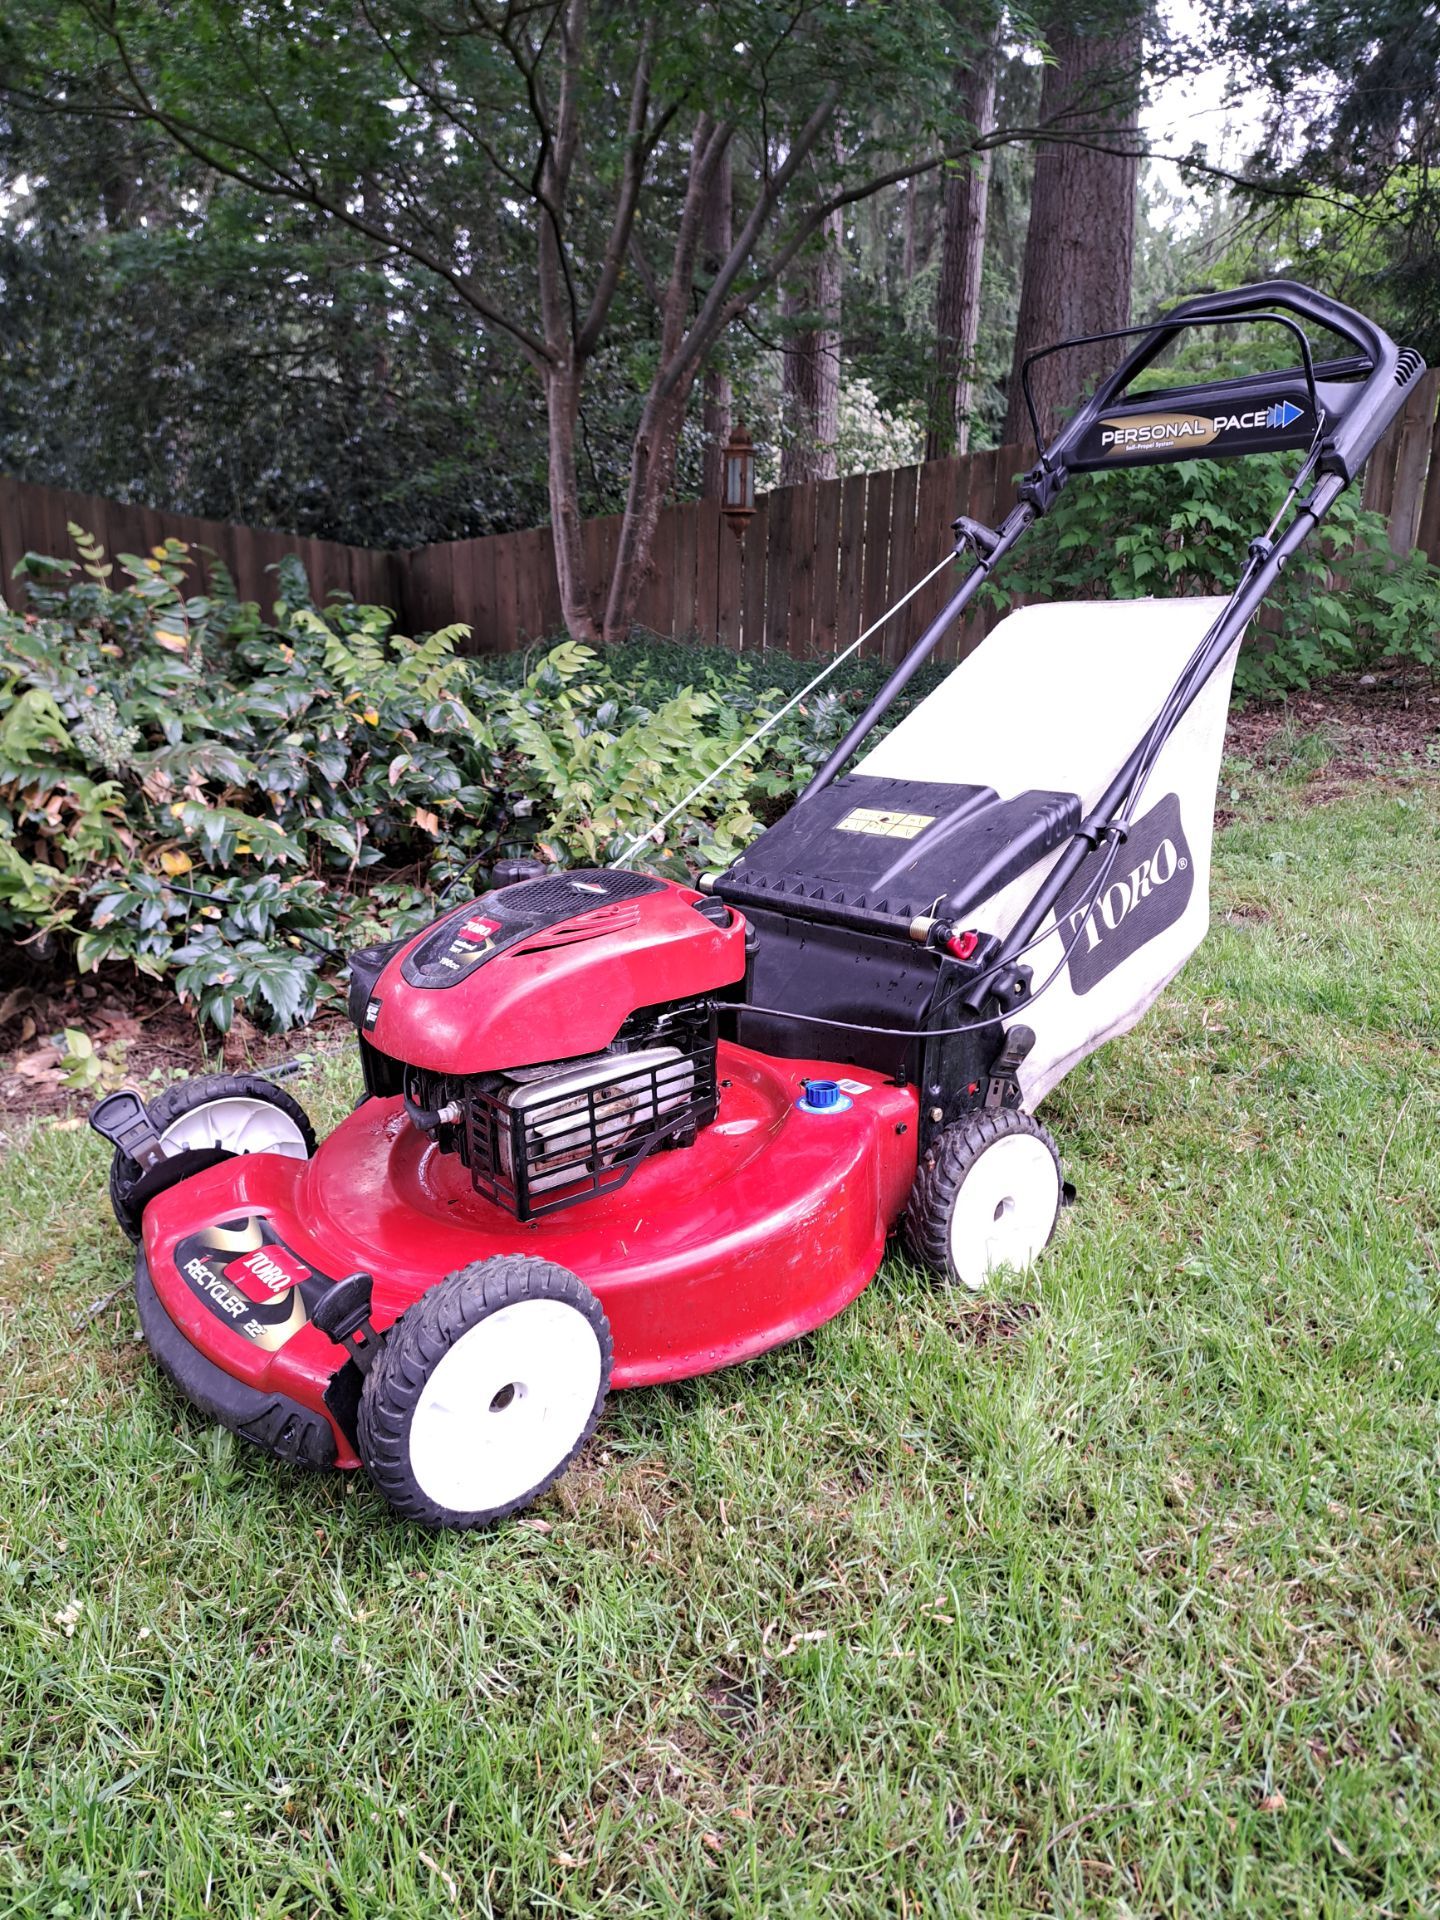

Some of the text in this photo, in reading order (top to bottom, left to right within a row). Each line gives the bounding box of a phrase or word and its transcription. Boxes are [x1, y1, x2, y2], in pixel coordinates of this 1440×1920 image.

[1101, 410, 1268, 446] PERSONAL PACE
[183, 1258, 248, 1318] RECYCLER
